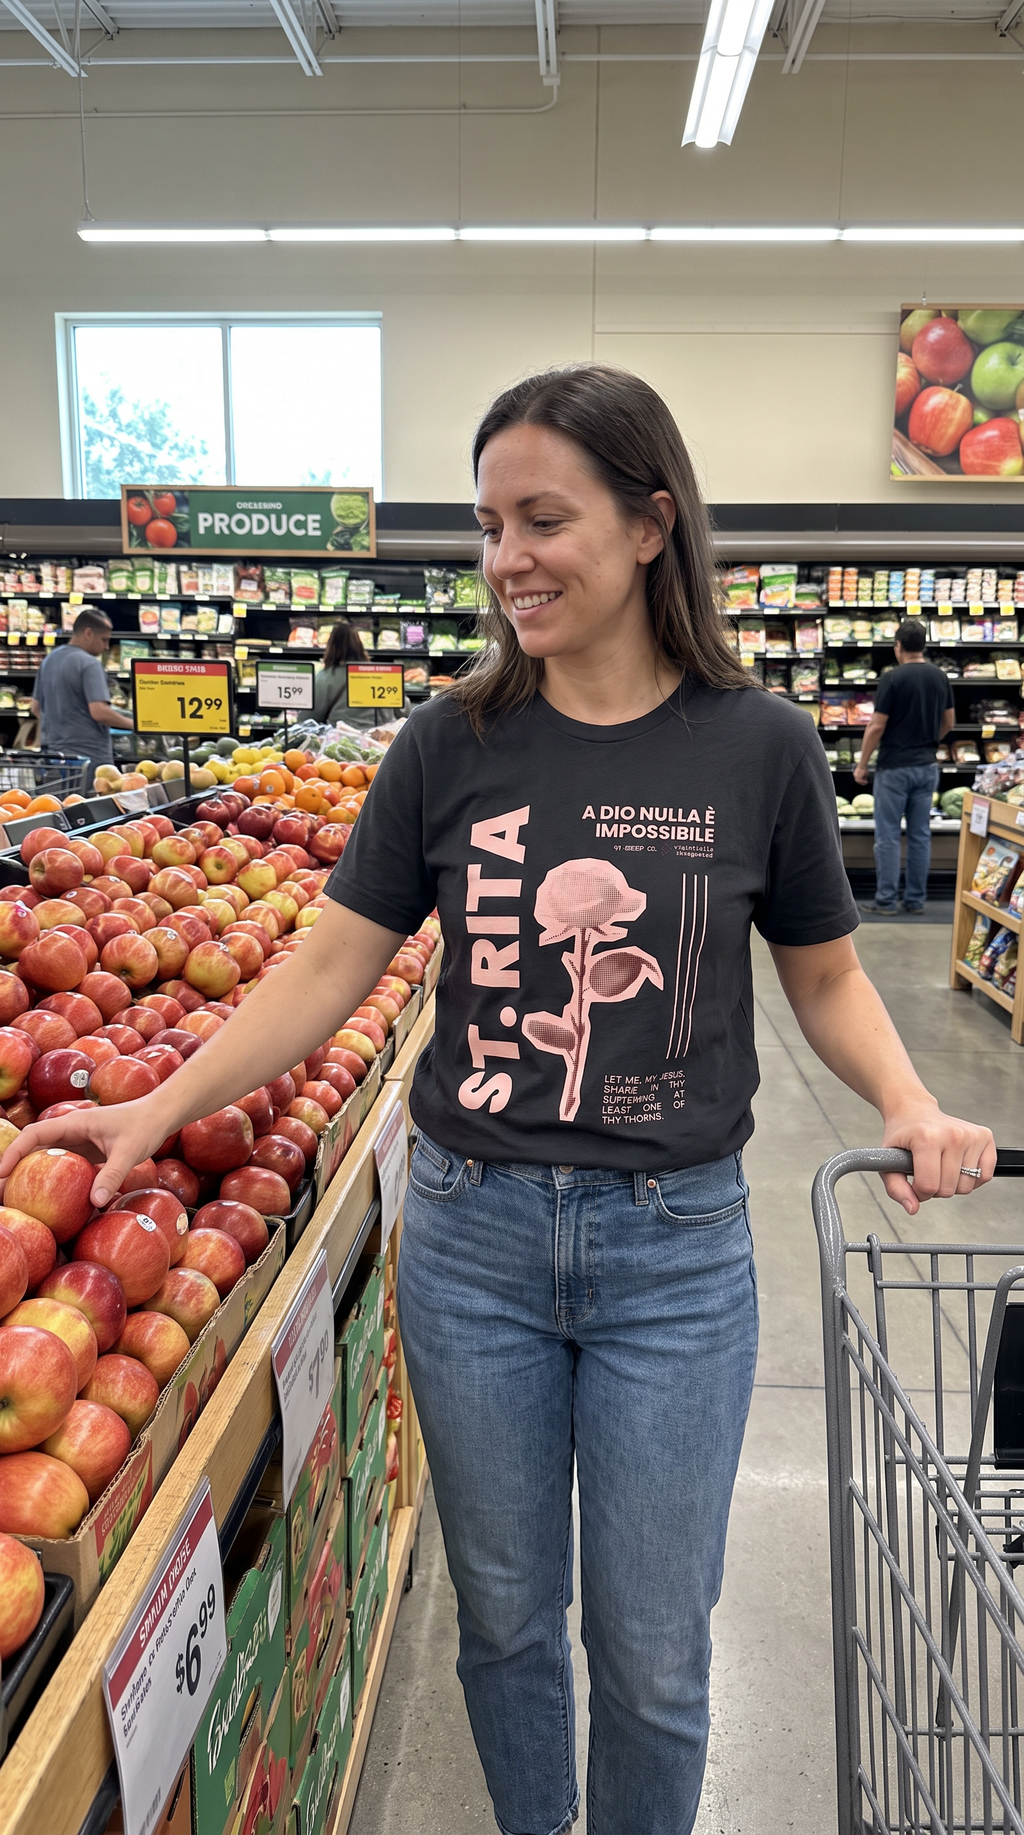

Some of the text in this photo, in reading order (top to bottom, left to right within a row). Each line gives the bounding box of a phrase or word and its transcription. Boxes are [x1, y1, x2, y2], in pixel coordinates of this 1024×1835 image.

[197, 512, 322, 537] PRODUCE
[581, 805, 716, 825] A DIO NULLA È
[595, 823, 715, 843] IMPOSSIBILE
[458, 805, 530, 1114] ST. RITA
[604, 1075, 622, 1084] LET
[644, 1074, 658, 1084] MY
[650, 1083, 660, 1092] IN
[669, 1080, 686, 1089] THY
[673, 1090, 686, 1099] AT
[602, 1100, 686, 1115] LEAST ONE OF
[602, 1112, 665, 1125] THY THORNS.
